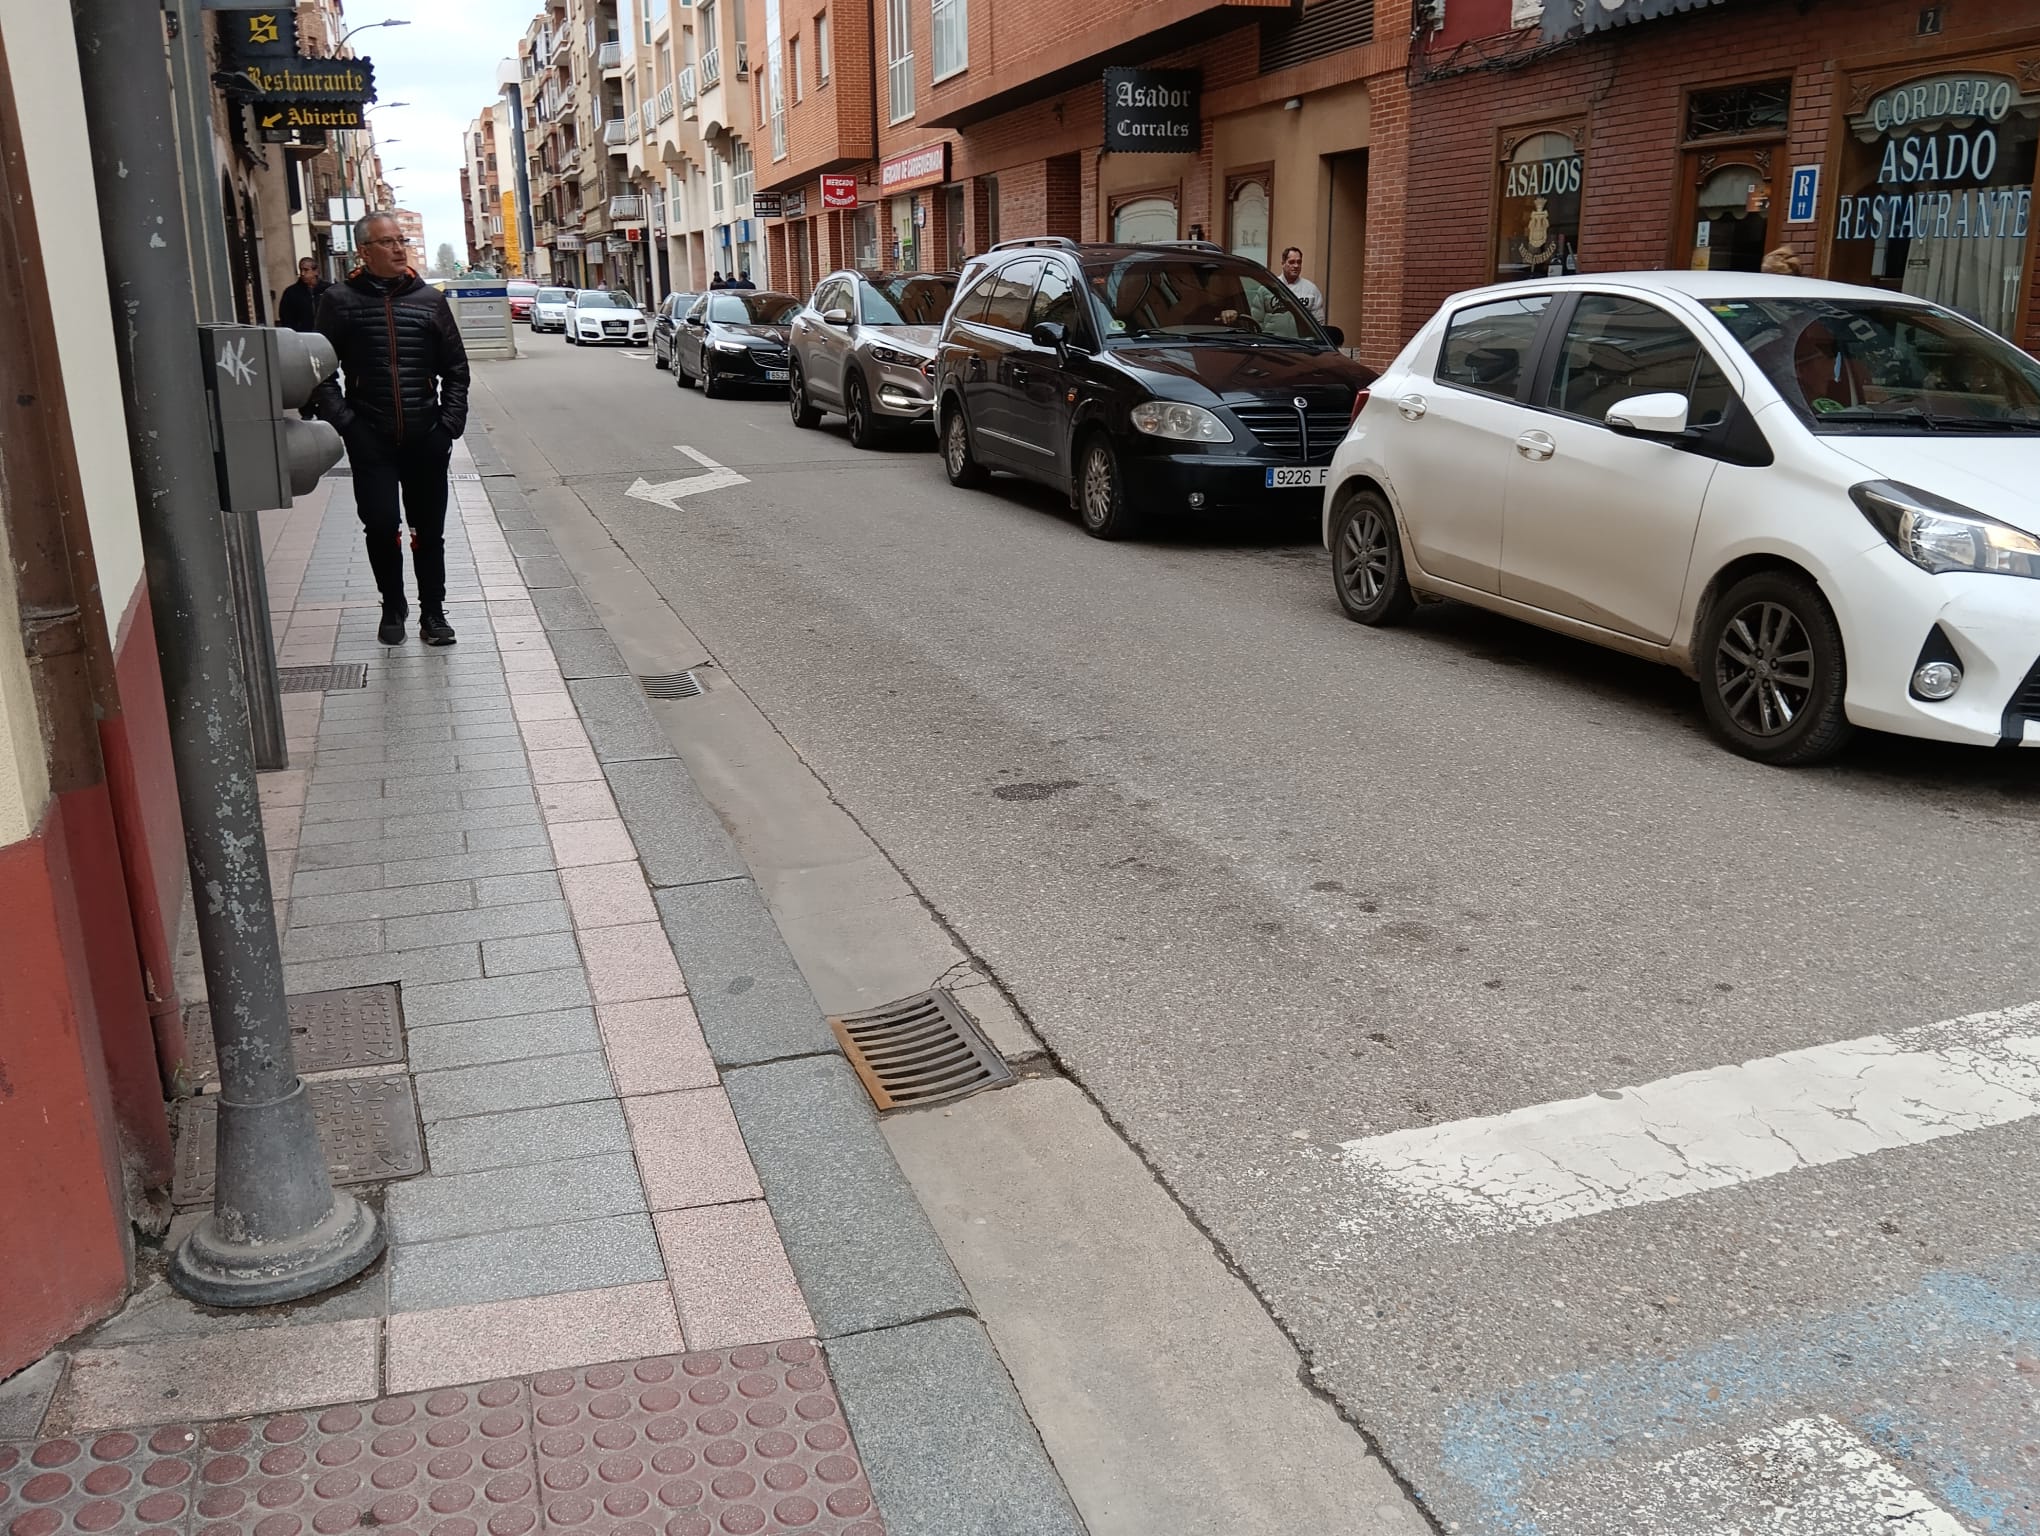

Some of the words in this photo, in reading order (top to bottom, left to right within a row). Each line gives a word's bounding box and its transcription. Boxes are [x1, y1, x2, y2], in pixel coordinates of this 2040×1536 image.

[247, 66, 363, 92] Restaurante
[1115, 81, 1192, 108] Asador
[1874, 80, 2011, 132] CORDERO
[287, 107, 359, 126] Abierto
[1117, 119, 1190, 137] Corrales
[1876, 129, 1998, 185] ASADO
[825, 178, 855, 188] MERCADO
[1505, 158, 1582, 198] ASADOS
[1798, 175, 1811, 197] R
[836, 188, 845, 196] DE
[1836, 189, 2033, 240] RESTAURANTE
[1276, 469, 1313, 485] 9226
